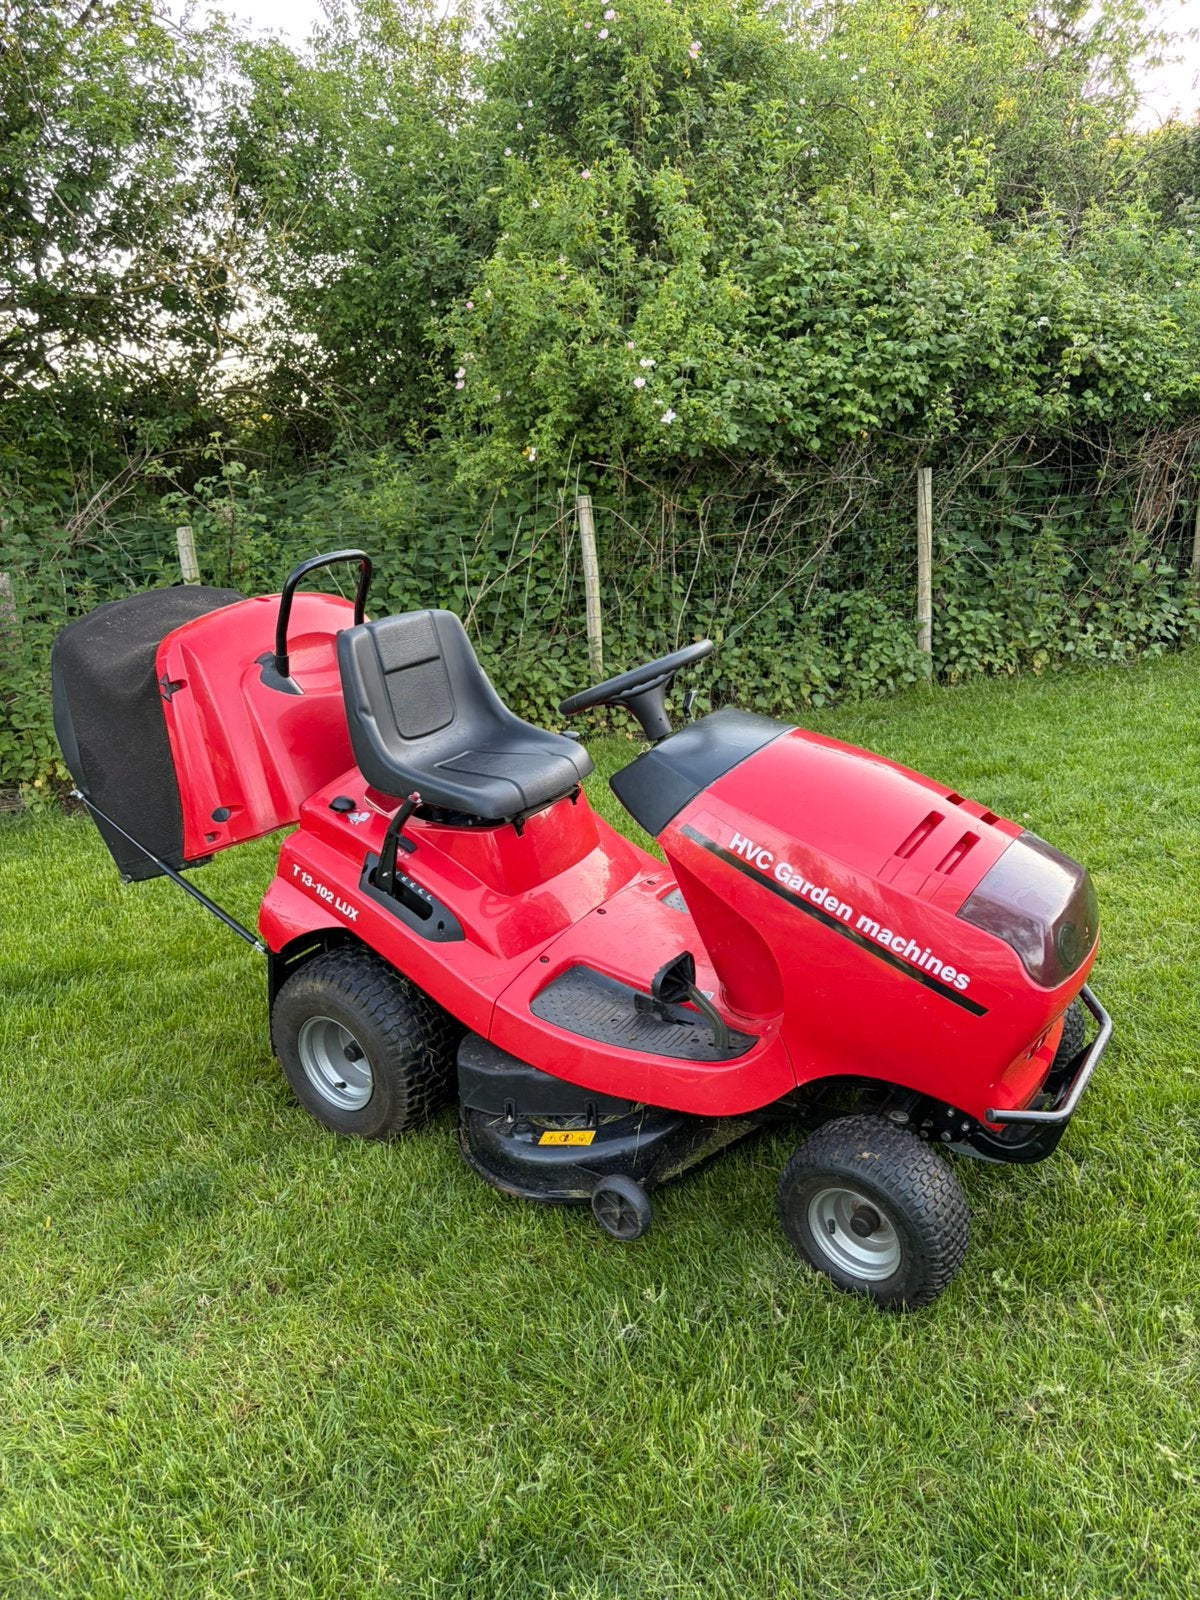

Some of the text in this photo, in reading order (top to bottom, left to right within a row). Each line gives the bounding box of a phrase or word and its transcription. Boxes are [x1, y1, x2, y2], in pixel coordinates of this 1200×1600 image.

[293, 864, 360, 922] T 13-102 LUX
[729, 832, 971, 990] HVC Garden machines
